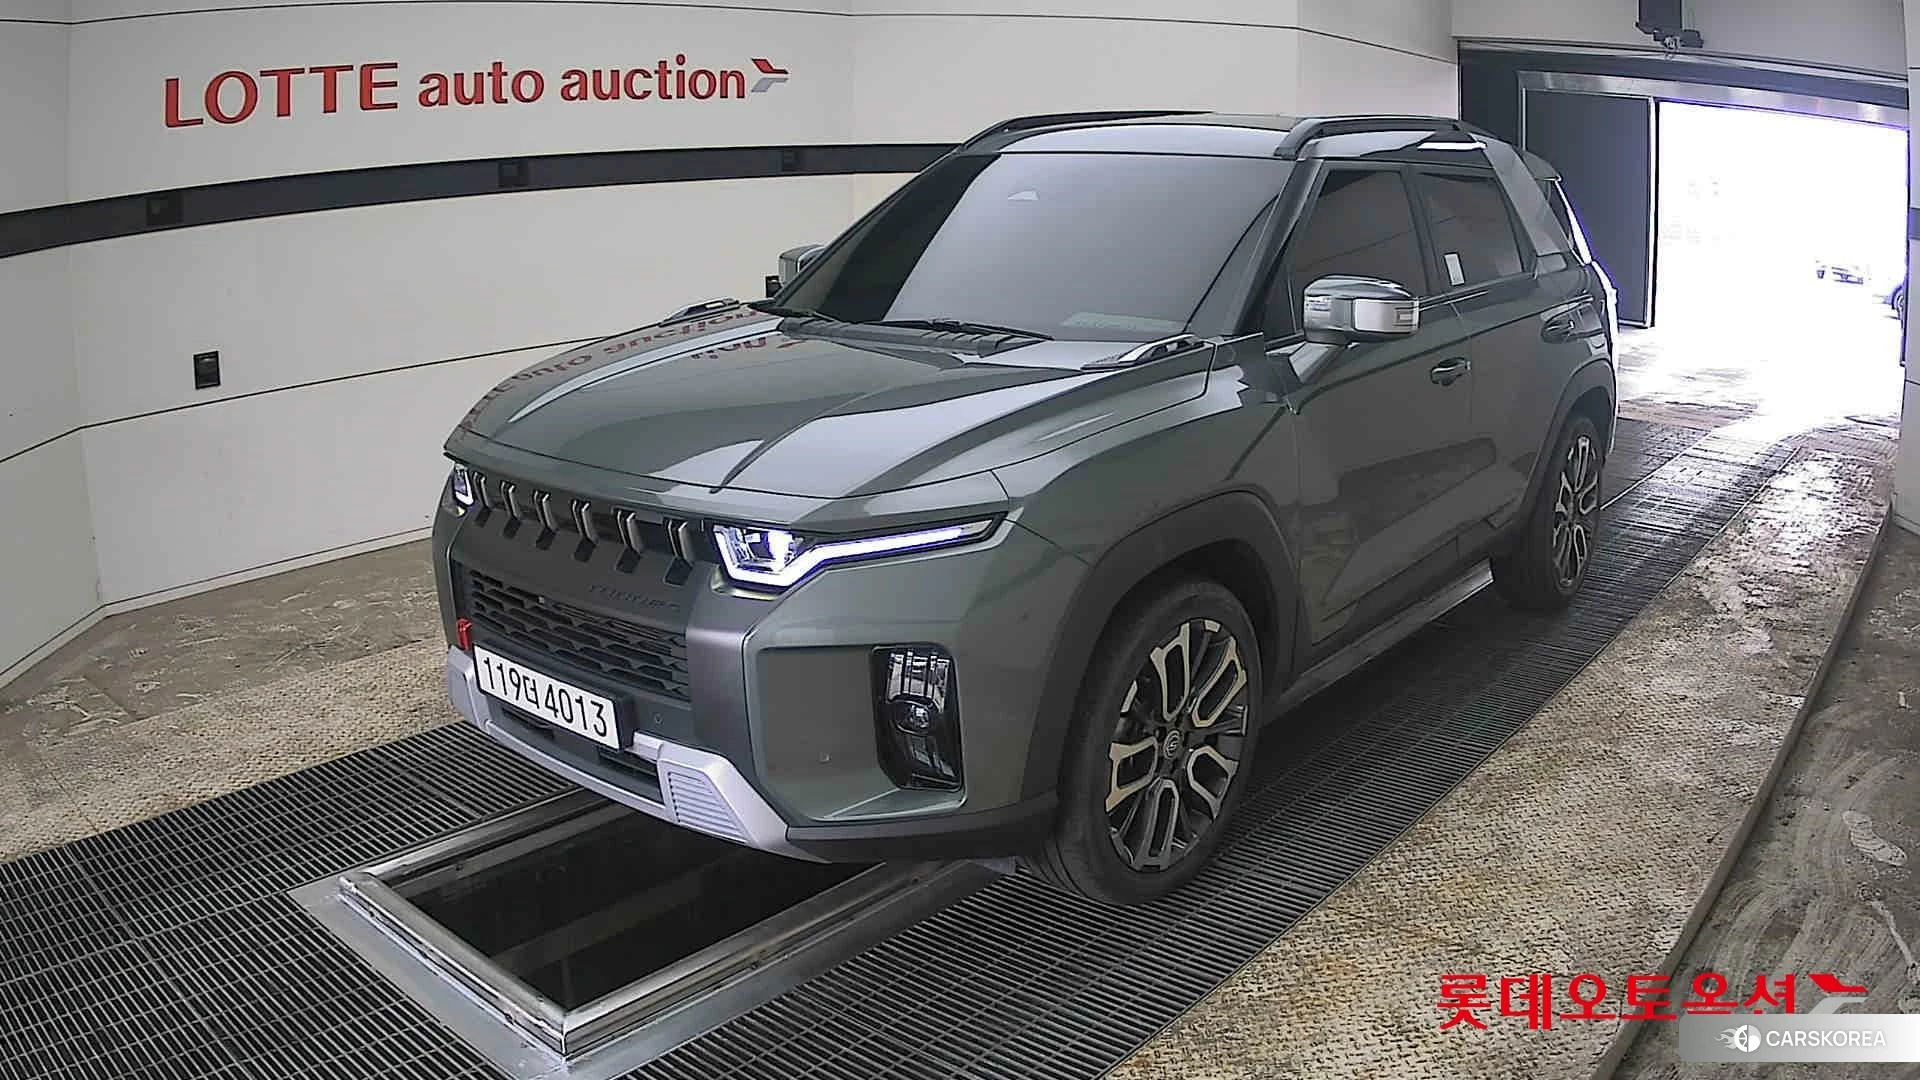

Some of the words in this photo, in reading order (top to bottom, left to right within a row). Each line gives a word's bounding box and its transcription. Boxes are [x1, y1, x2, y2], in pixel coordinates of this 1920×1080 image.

[164, 62, 399, 129] LOTTE
[418, 61, 545, 108] auto
[560, 53, 747, 101] auction
